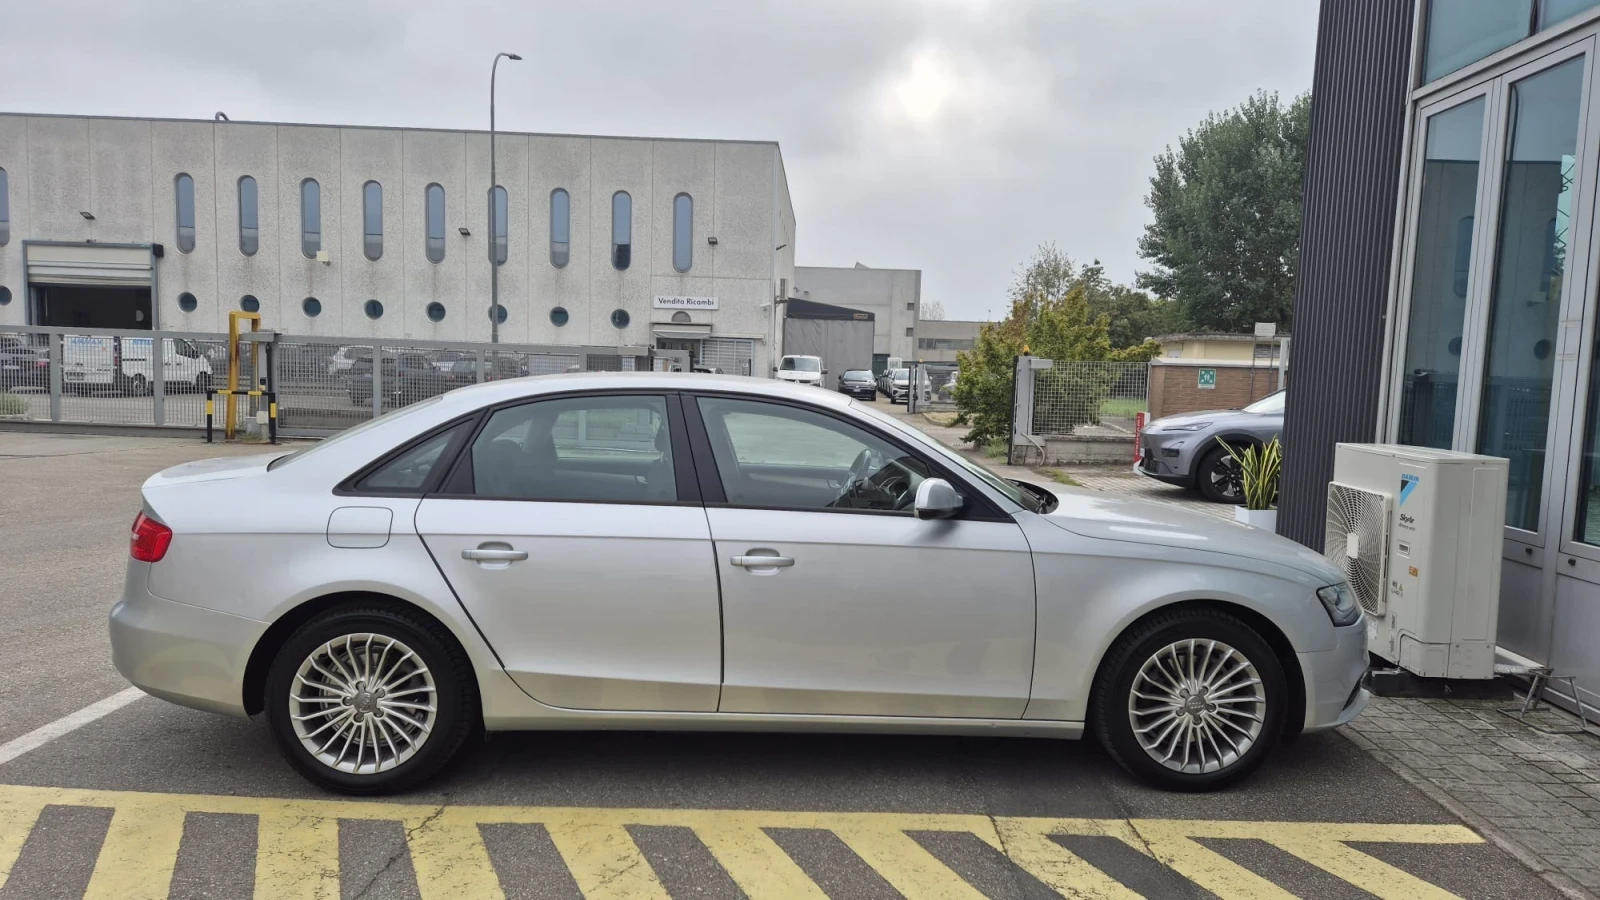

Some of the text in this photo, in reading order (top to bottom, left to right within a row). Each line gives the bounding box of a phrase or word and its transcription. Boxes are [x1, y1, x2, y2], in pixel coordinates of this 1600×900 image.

[658, 297, 714, 306] Vendita Ricambi
[1401, 473, 1419, 482] DAIKIN
